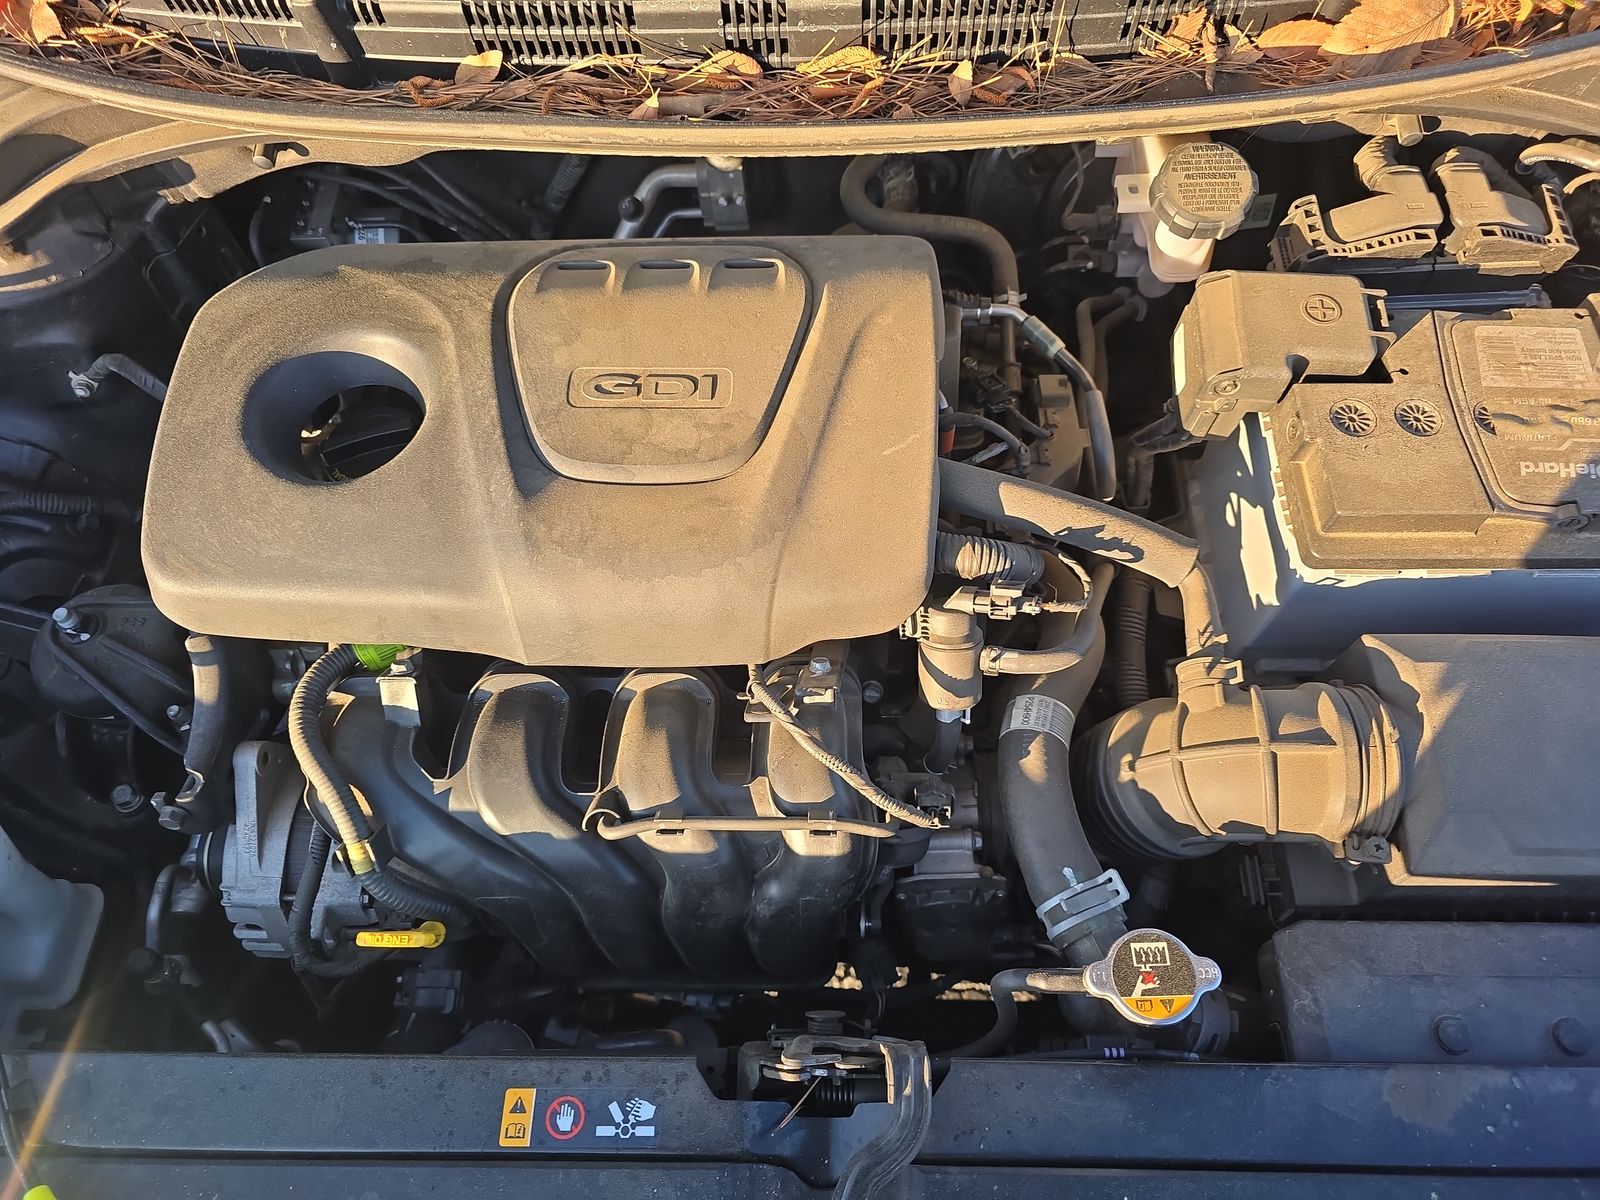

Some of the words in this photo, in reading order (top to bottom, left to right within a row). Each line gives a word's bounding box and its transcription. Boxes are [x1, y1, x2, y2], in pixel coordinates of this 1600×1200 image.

[582, 373, 718, 401] GDI
[366, 934, 382, 944] OIL
[384, 935, 408, 944] ENG
